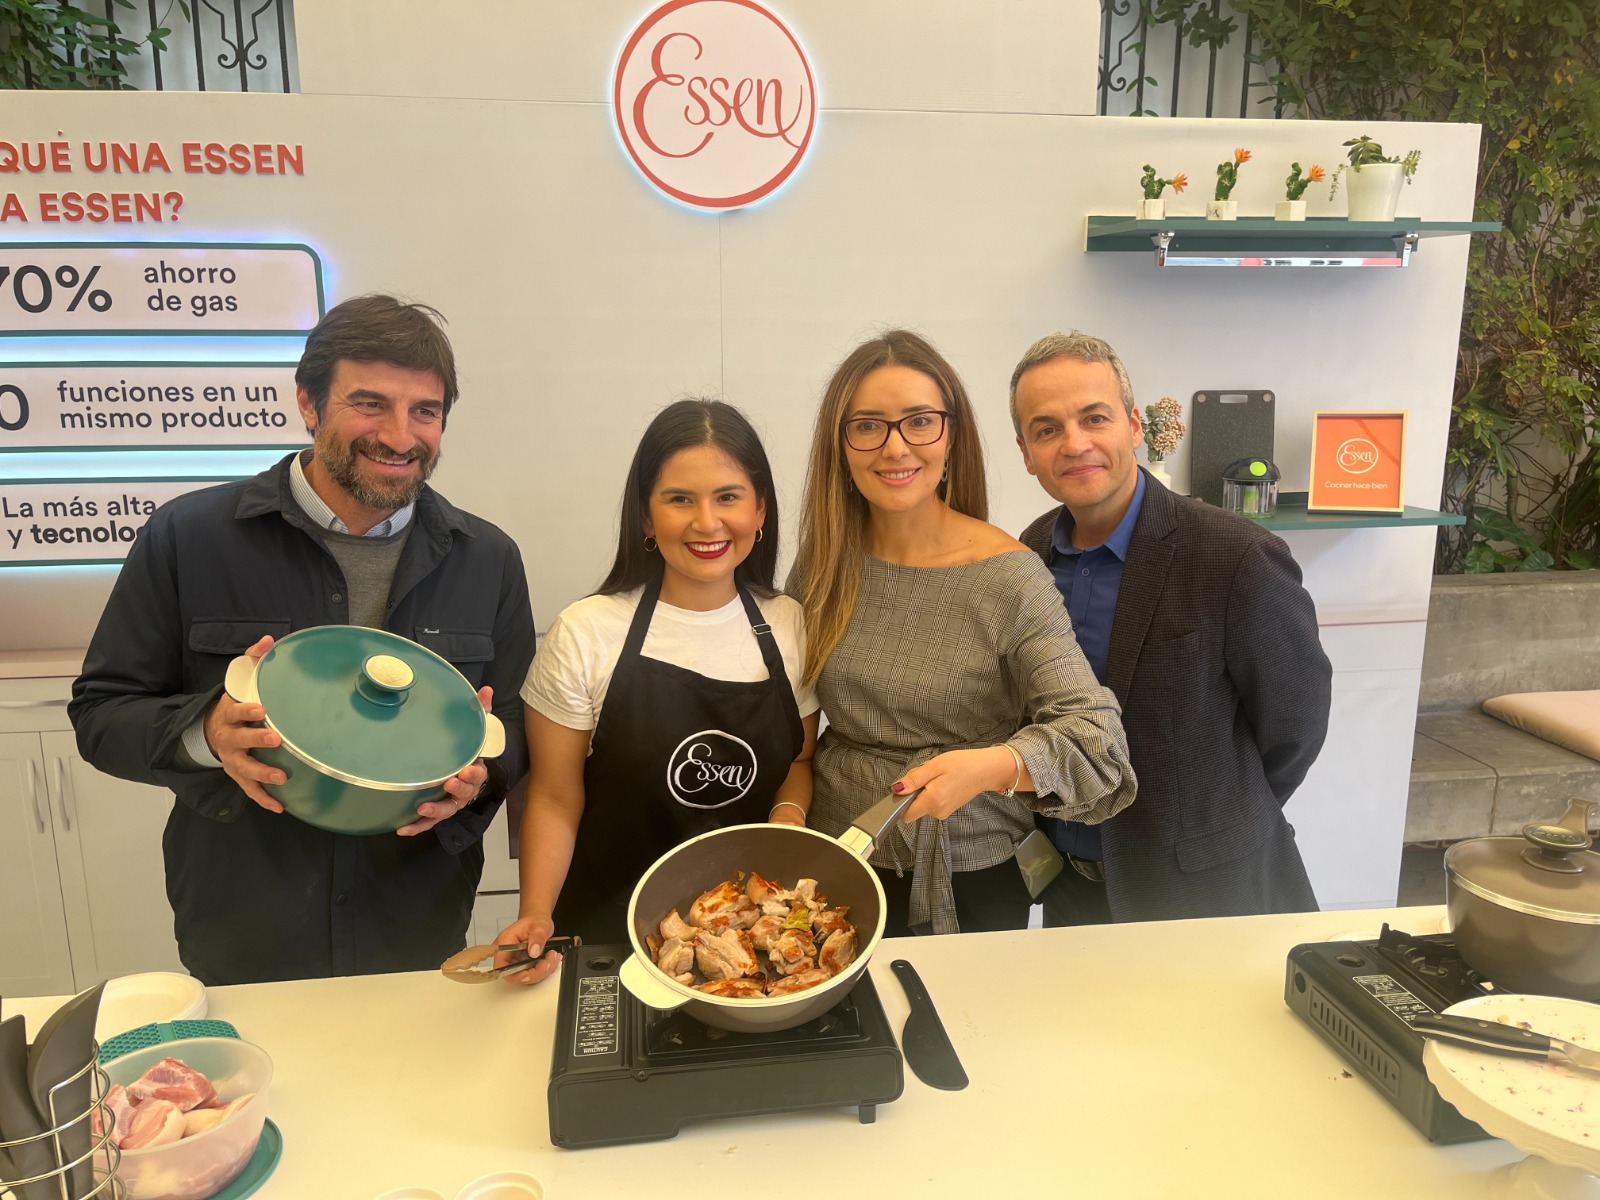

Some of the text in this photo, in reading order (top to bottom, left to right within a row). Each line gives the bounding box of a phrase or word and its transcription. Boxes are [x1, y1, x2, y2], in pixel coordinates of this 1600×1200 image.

[633, 32, 803, 158] Essen
[83, 142, 171, 174] UNA
[182, 142, 304, 175] ESSEN
[39, 191, 184, 222] ESSEN?
[144, 261, 236, 284] ahorro
[147, 288, 238, 317] de gas
[57, 380, 278, 402] funciones en un
[60, 406, 287, 433] mismo producto
[1340, 444, 1376, 466] Essen
[2, 494, 156, 518] La más alta
[7, 529, 23, 550] y
[674, 743, 752, 793] Essen
